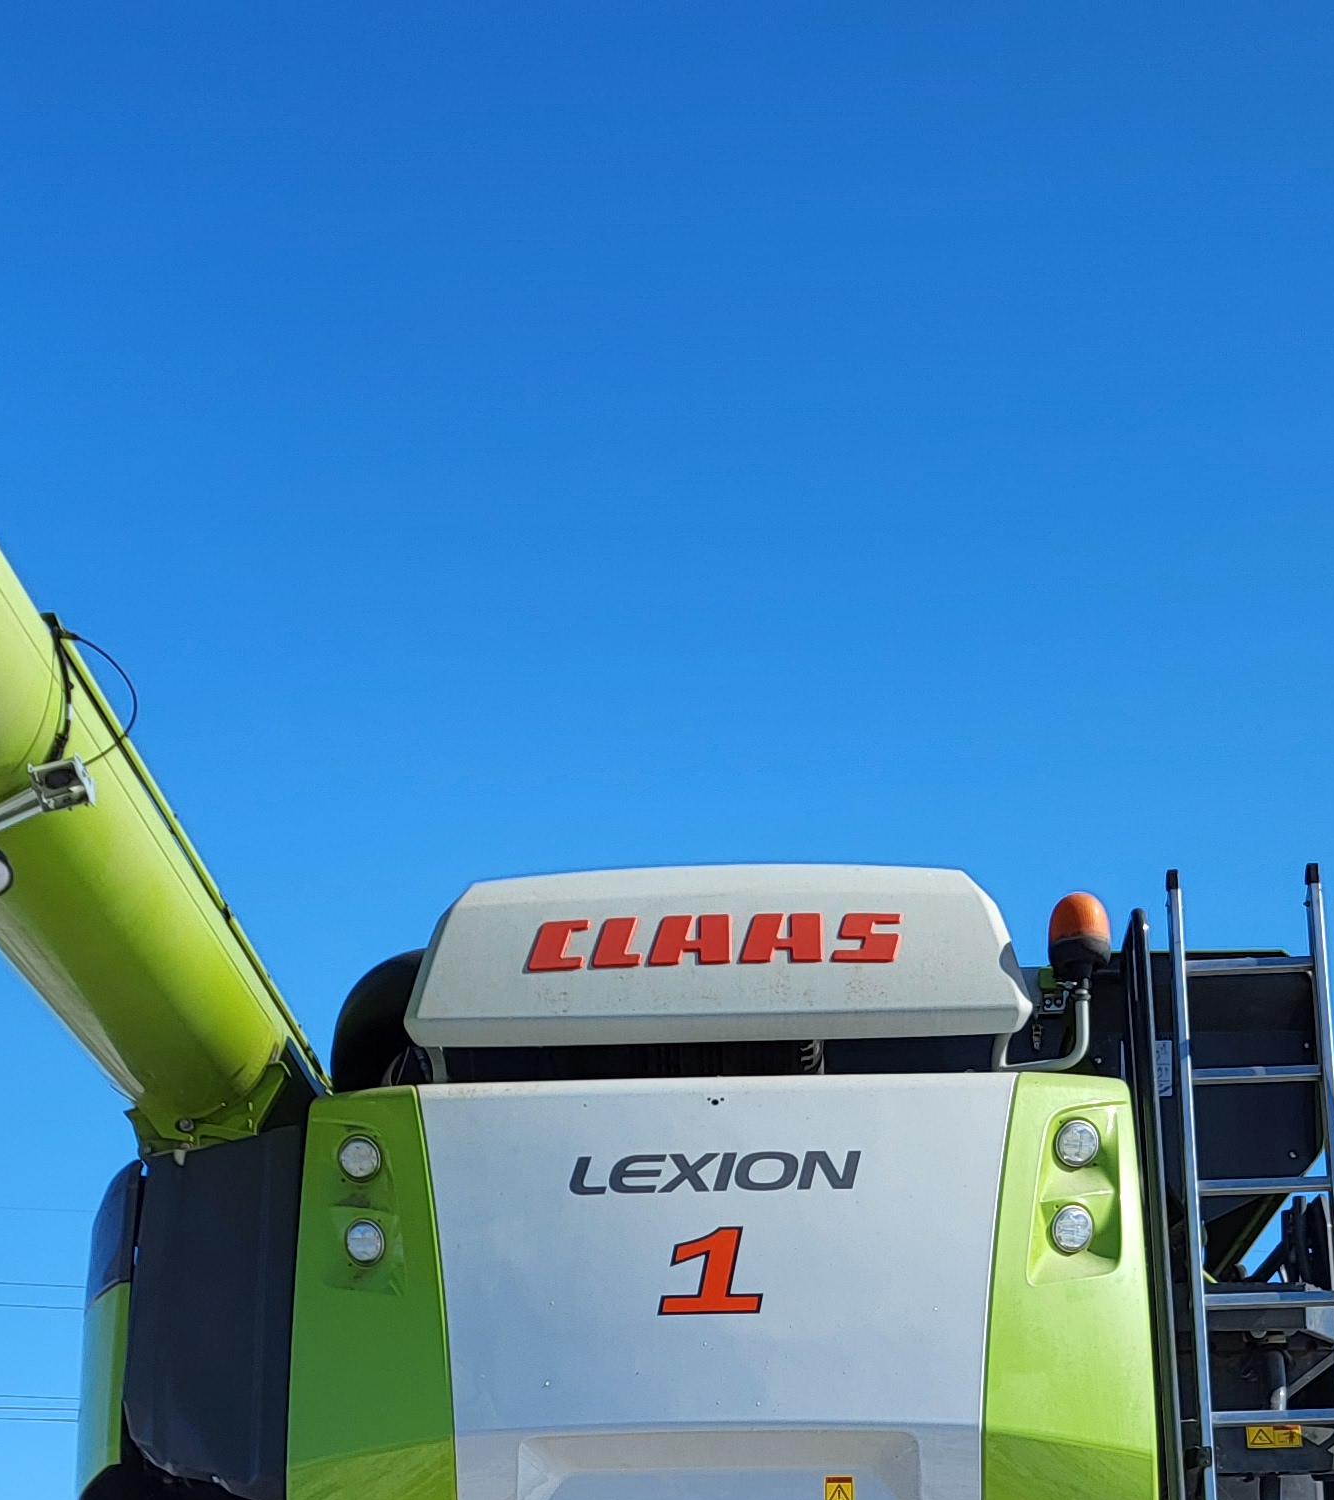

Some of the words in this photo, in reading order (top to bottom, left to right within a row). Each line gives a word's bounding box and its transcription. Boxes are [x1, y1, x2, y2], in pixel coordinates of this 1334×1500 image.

[526, 912, 902, 972] CLAAS
[568, 1150, 862, 1196] LEXION
[656, 1225, 764, 1317] 1
